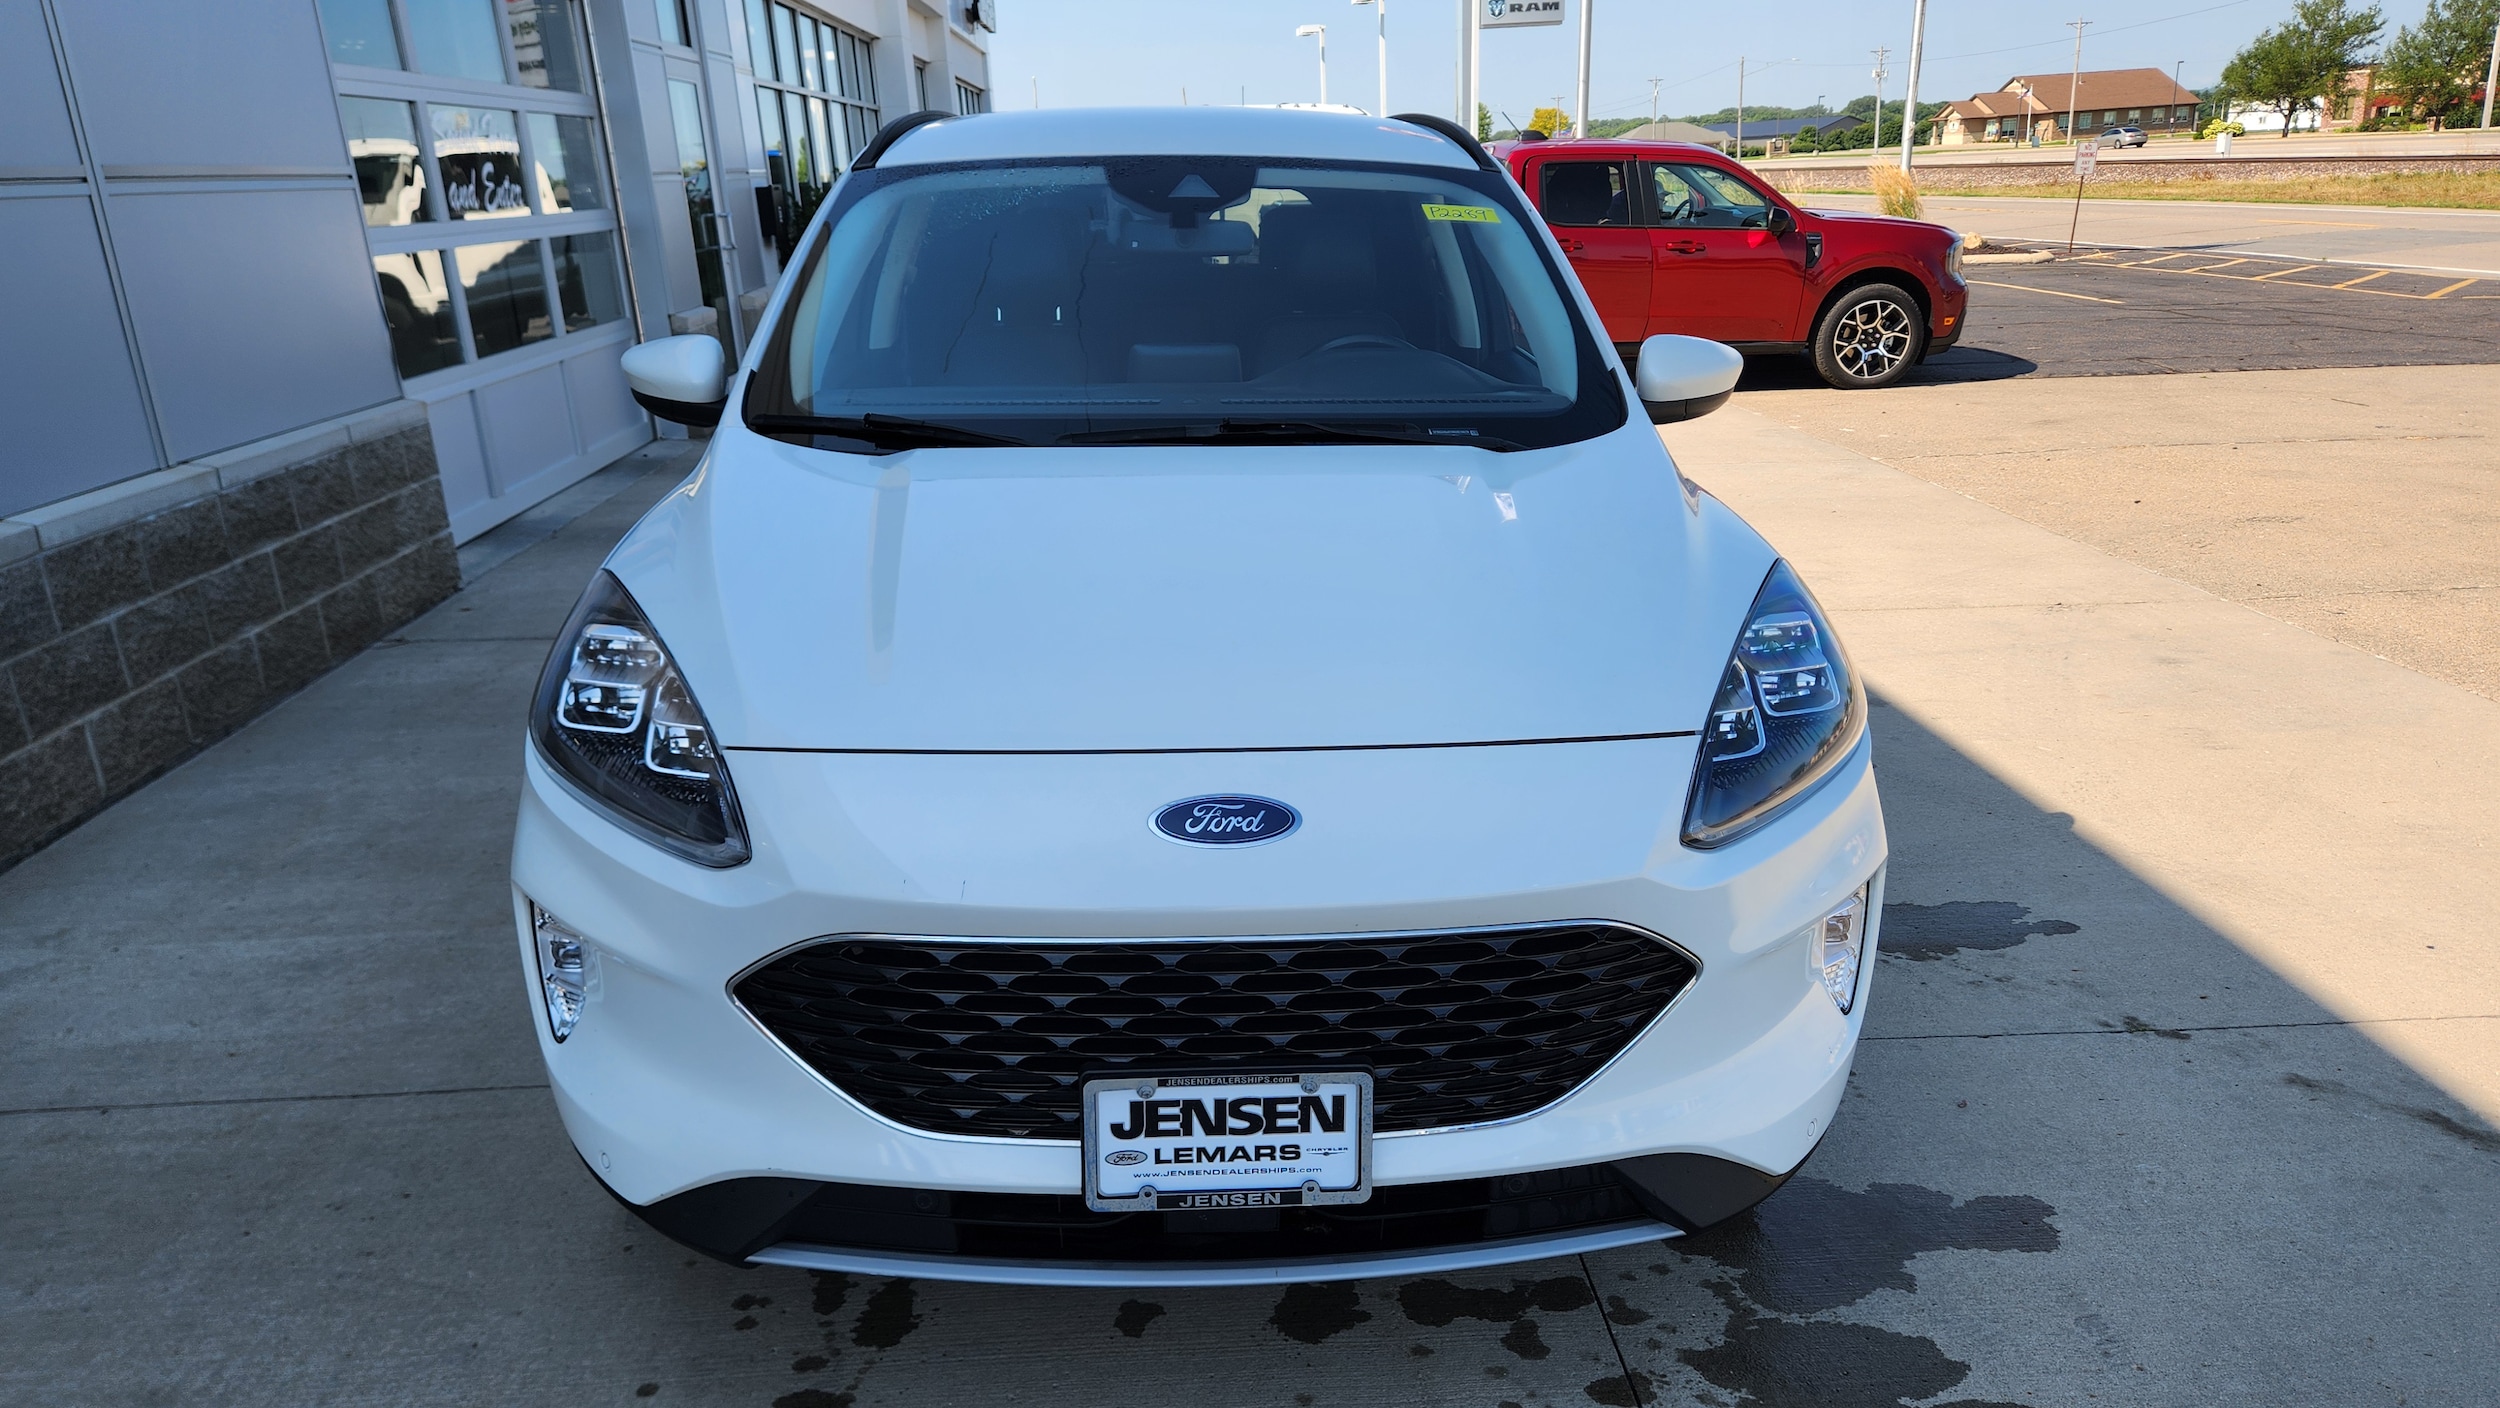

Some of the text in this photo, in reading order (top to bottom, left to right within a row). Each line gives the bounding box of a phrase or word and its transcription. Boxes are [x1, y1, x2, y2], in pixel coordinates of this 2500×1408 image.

[1509, 2, 1560, 13] RAM
[448, 161, 523, 213] and Enter
[1184, 803, 1266, 834] Ford
[1165, 1075, 1294, 1087] JENSENDEALERSHIPS.com
[1109, 1094, 1347, 1140] JENSEN
[1153, 1144, 1302, 1165] LEMARS
[1132, 1167, 1323, 1179] www.JENSENDEALERSHIPS.com
[1178, 1191, 1282, 1208] JENSEN
